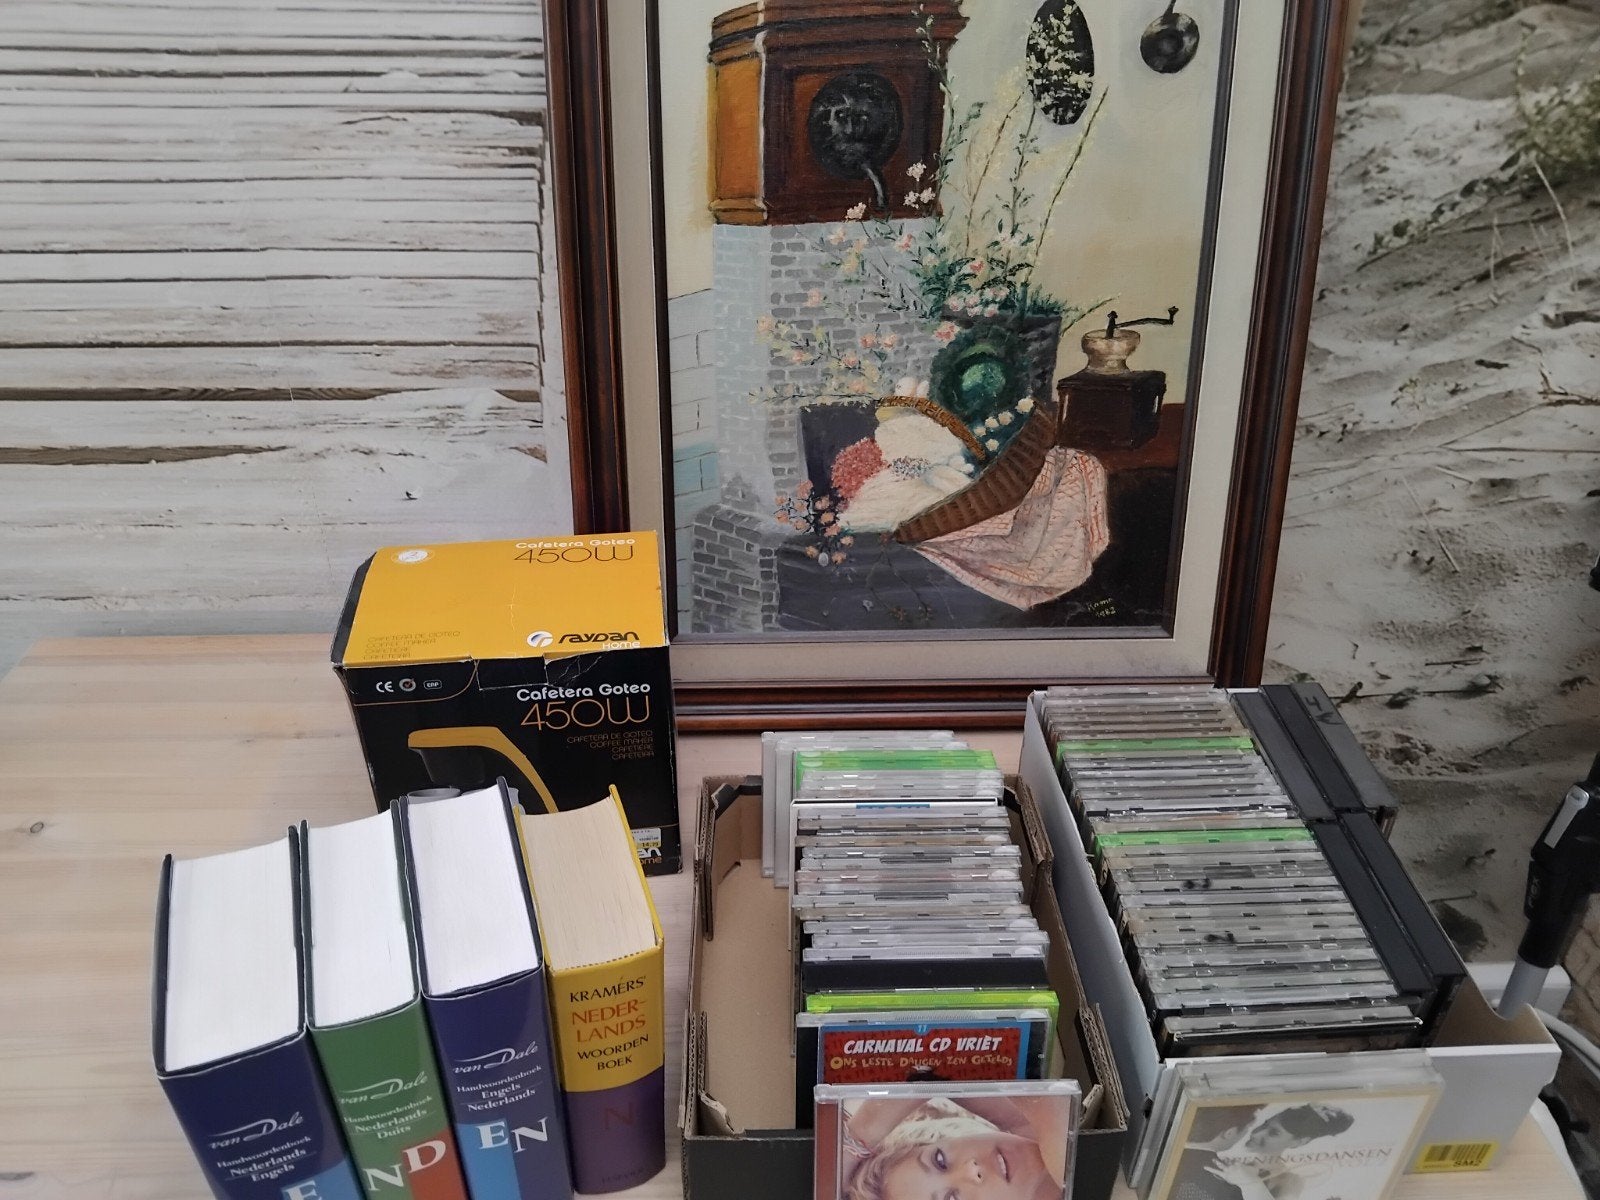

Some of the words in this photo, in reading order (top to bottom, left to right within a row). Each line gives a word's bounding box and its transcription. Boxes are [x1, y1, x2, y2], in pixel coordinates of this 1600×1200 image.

[513, 545, 634, 564] 450W
[515, 540, 584, 549] Cafetera
[589, 538, 636, 547] Goteo
[375, 681, 394, 693] CE
[516, 686, 594, 702] Cafetera
[598, 683, 651, 696] Goteo
[520, 695, 650, 731] 450W
[571, 998, 647, 1025] NEDER-
[576, 1014, 647, 1043] LANDS
[454, 1040, 539, 1069] Dale
[577, 1033, 649, 1060] WOORDEN
[843, 1038, 924, 1055] CARNAVAL
[929, 1037, 952, 1053] CD
[453, 1064, 482, 1074] van
[597, 1055, 633, 1071] BOEK
[342, 1071, 428, 1100] Dale
[457, 1065, 542, 1092] Handwoordenboek
[338, 1094, 368, 1105] van
[467, 1088, 536, 1112] Nederlands
[481, 1083, 521, 1099] Engels
[344, 1095, 433, 1123] Handwoordenboek
[354, 1108, 428, 1133] Nederlands
[208, 1111, 304, 1142] Dale
[377, 1125, 411, 1139] Duits
[208, 1136, 242, 1149] van
[216, 1135, 312, 1169] Handwoordenboek
[229, 1148, 307, 1177] Nederlands
[250, 1163, 295, 1182] Engels
